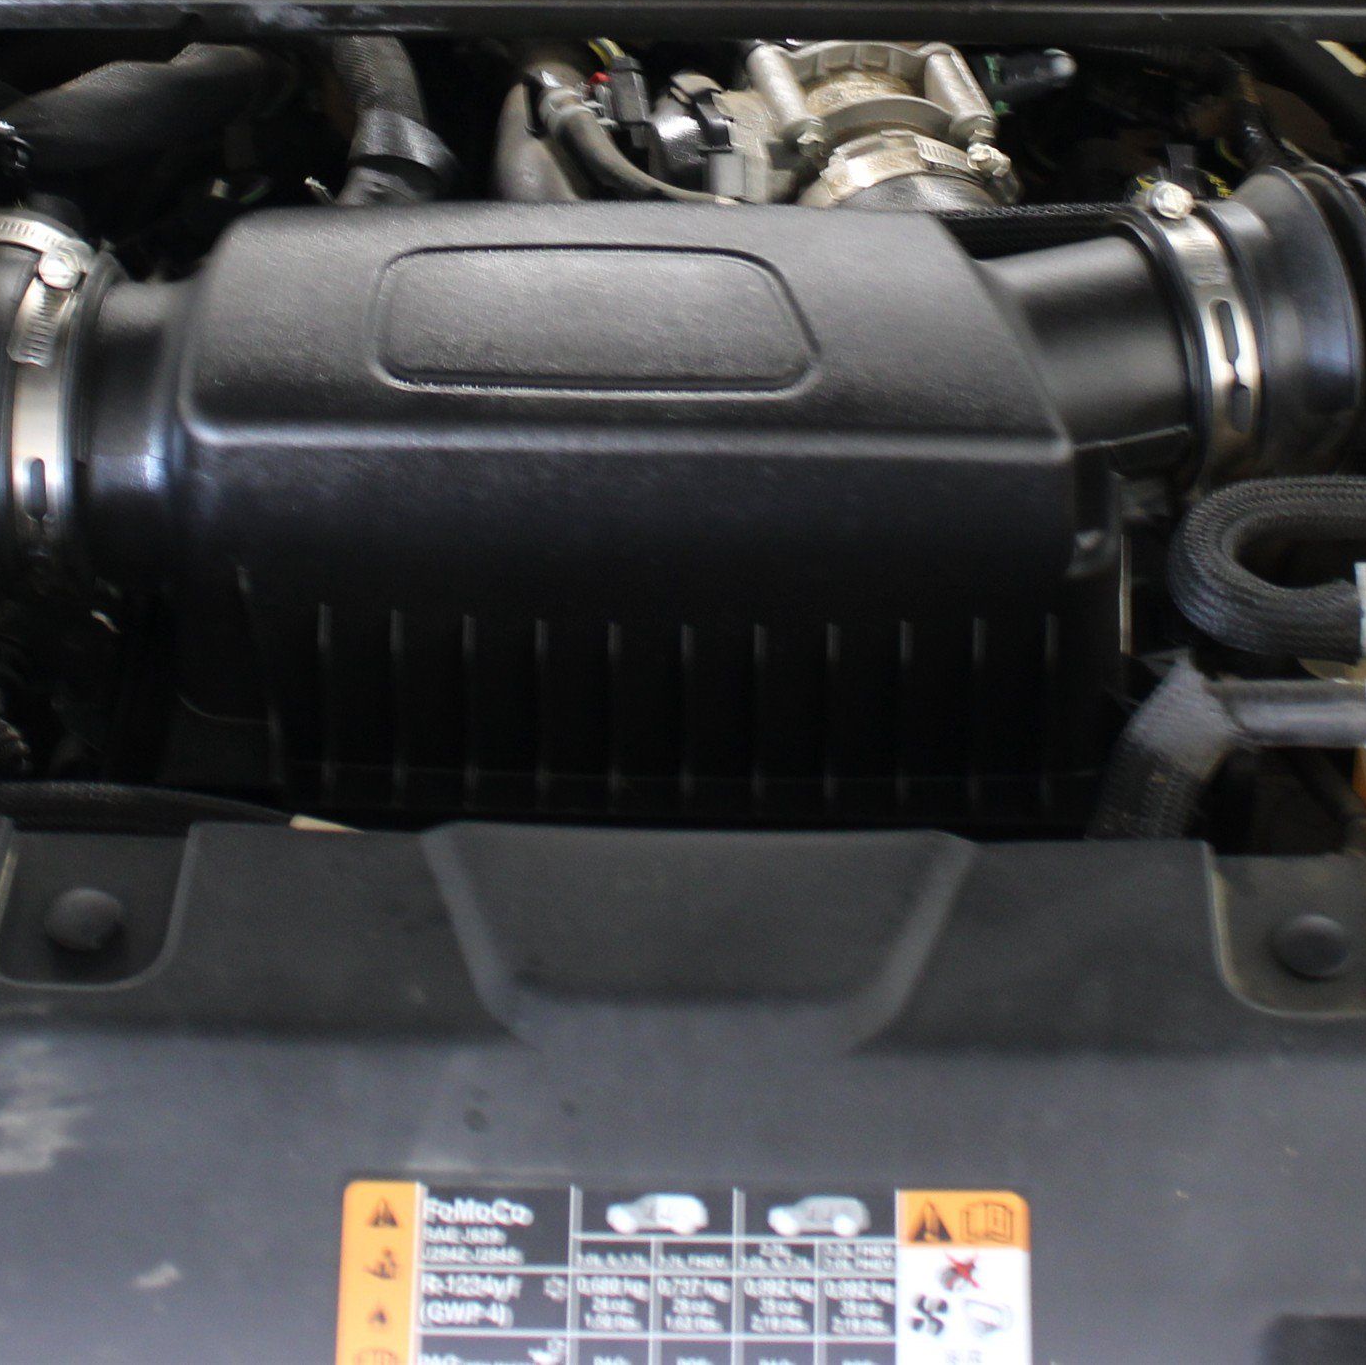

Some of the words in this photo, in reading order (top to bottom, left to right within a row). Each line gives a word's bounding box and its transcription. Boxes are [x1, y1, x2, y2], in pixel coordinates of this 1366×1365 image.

[423, 1197, 534, 1226] FoMoCo
[421, 1272, 523, 1303] R-1234yf
[623, 1277, 650, 1302] kg
[704, 1278, 731, 1303] kg
[791, 1279, 815, 1304] kg
[870, 1280, 896, 1306] kg
